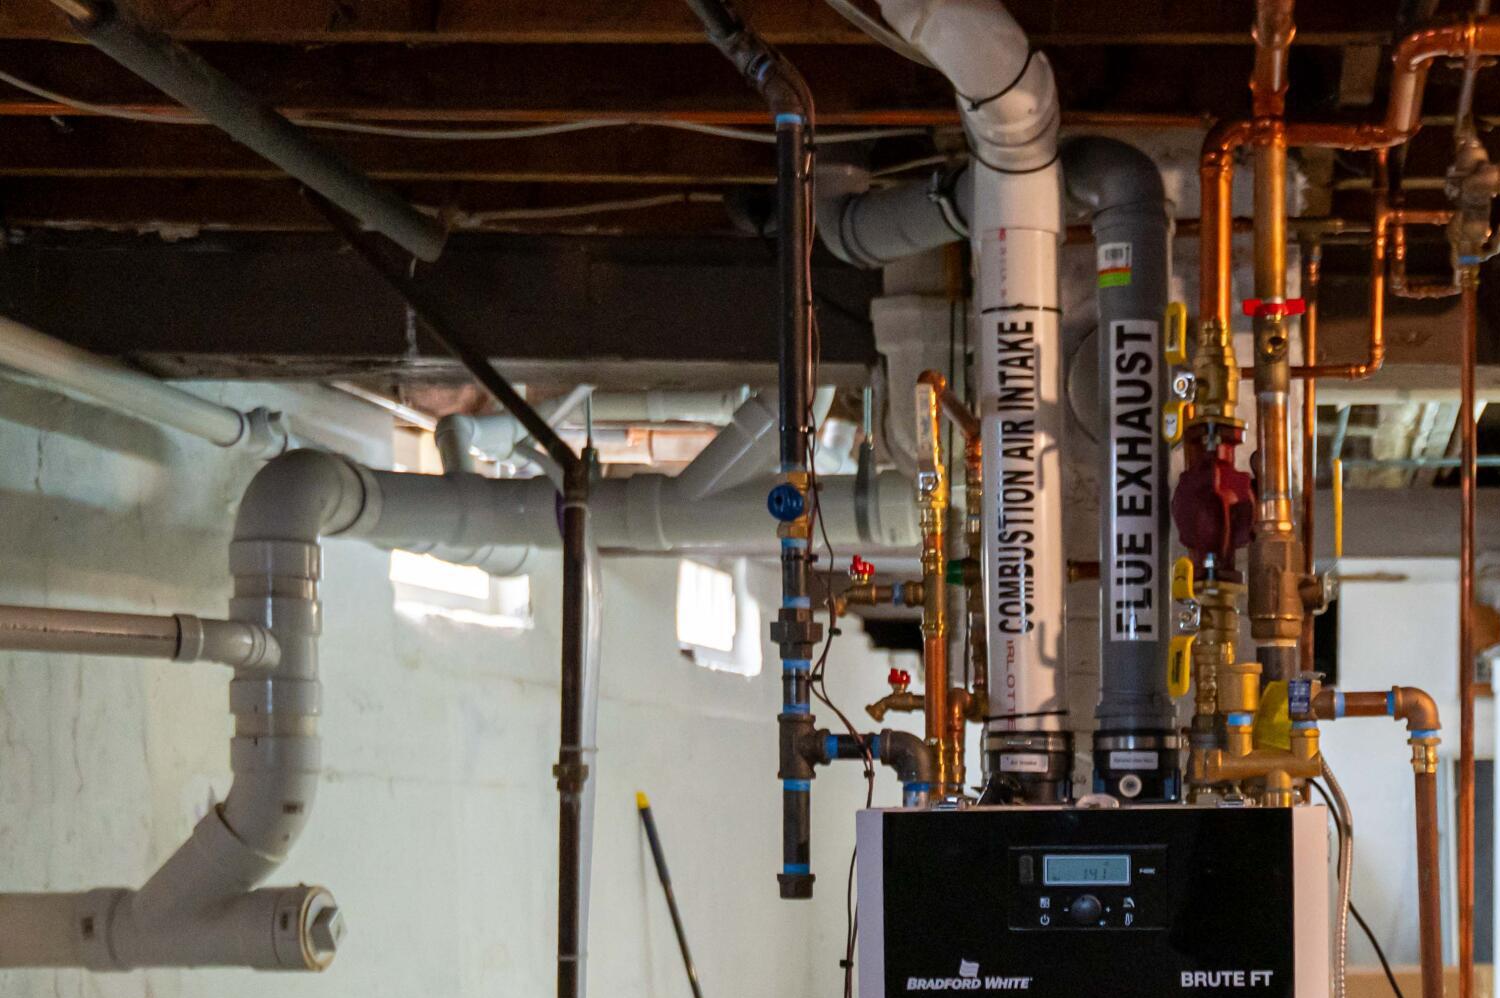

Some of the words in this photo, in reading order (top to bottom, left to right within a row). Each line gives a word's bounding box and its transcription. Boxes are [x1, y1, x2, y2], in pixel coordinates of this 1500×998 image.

[997, 321, 1035, 412] INTAKE
[1001, 419, 1035, 462] AIR
[1115, 325, 1153, 517] EXHAUST
[998, 471, 1035, 635] COMBUSTION
[1116, 532, 1153, 634] FLUE
[907, 977, 981, 990] BRADFORD
[984, 976, 1030, 989] WHITE
[1181, 970, 1246, 987] BRUTE
[1250, 970, 1274, 987] FT
